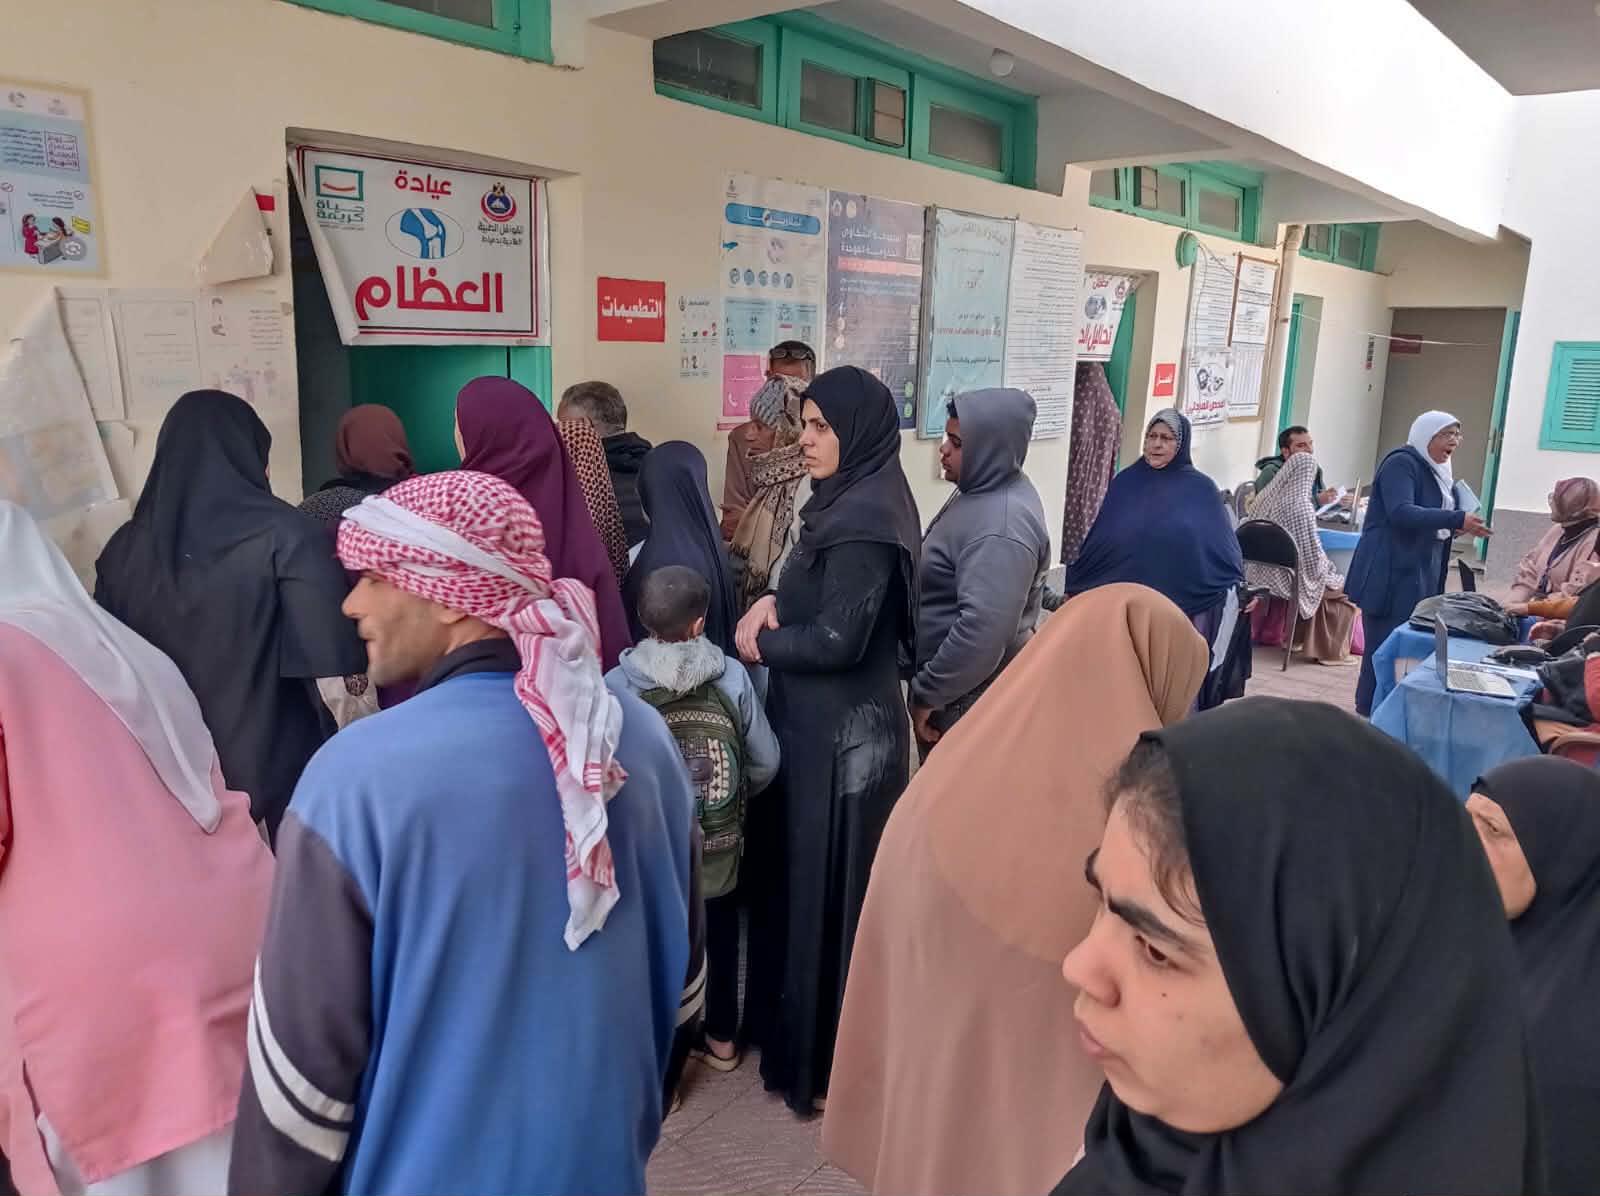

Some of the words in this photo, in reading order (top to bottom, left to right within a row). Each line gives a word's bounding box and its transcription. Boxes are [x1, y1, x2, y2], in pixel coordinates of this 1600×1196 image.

[394, 170, 452, 200] عيادة
[355, 265, 504, 321] العظام
[601, 296, 663, 324] التطعيمات
